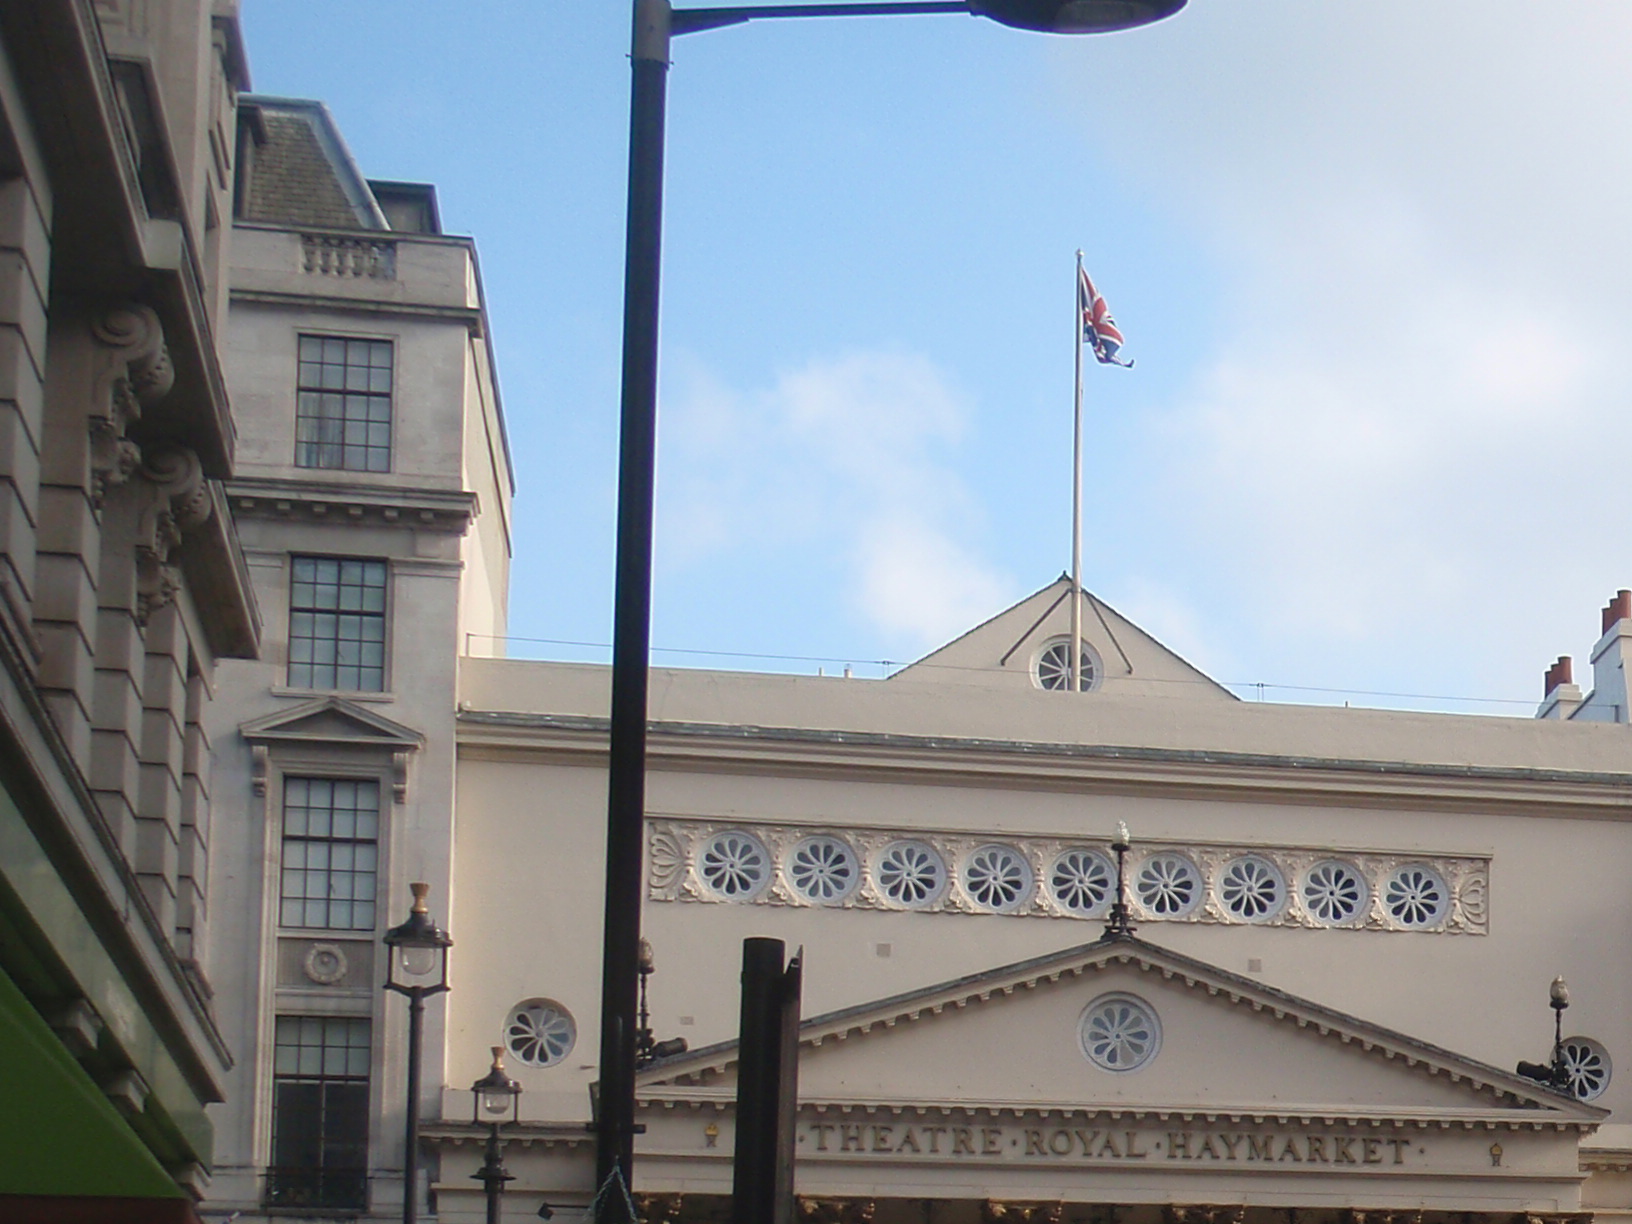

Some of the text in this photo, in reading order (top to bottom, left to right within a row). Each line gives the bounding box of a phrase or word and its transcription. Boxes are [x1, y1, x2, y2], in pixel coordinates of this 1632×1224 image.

[809, 1124, 1411, 1165] THEATRE ROYAL HAYMARKET
